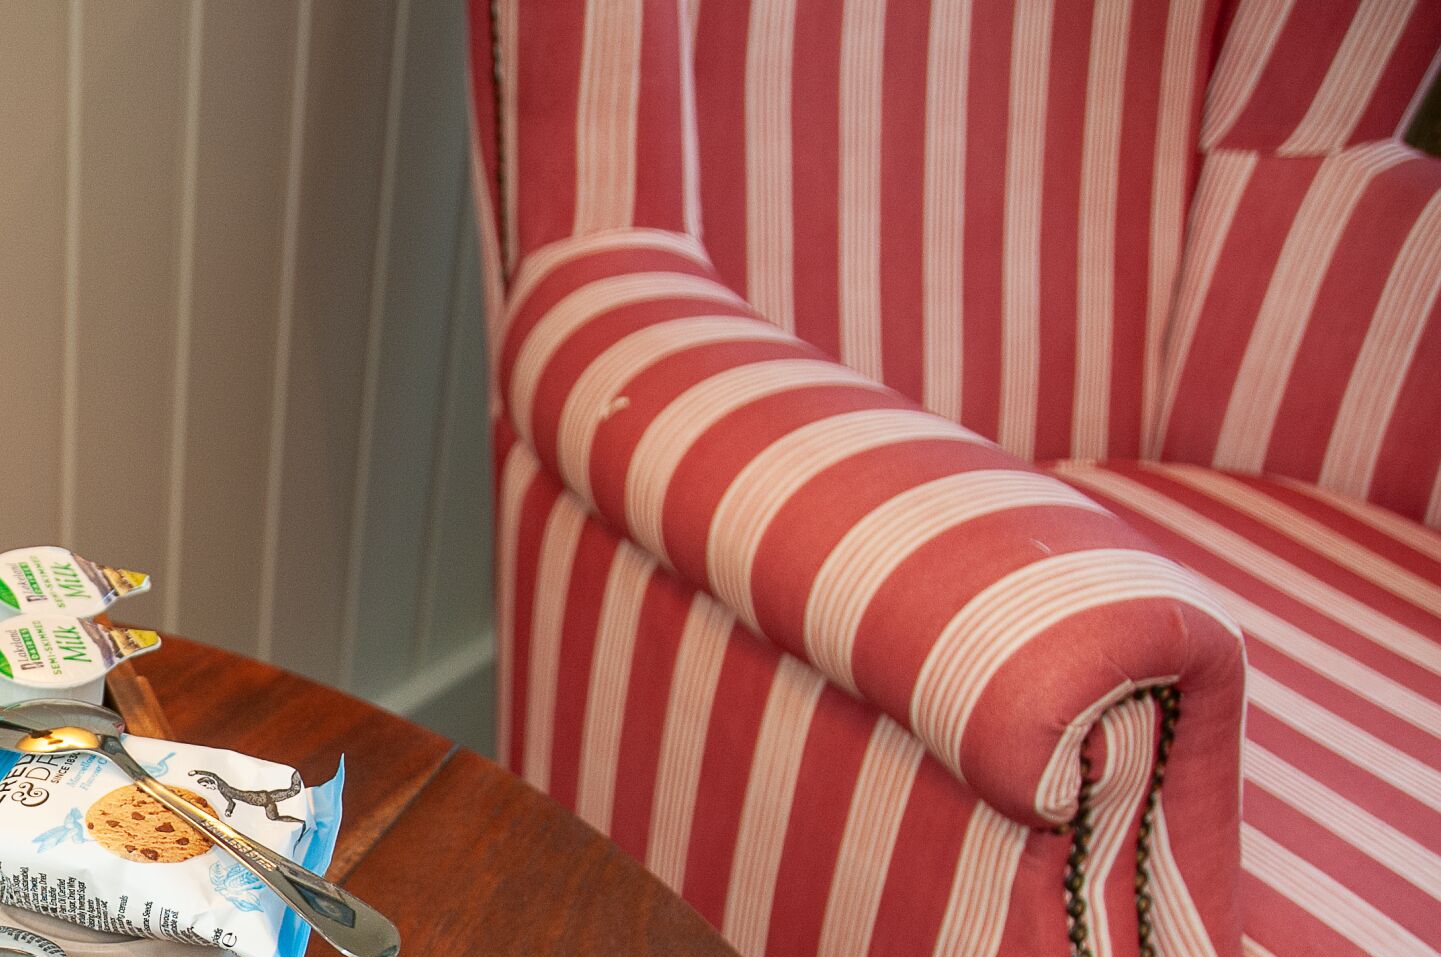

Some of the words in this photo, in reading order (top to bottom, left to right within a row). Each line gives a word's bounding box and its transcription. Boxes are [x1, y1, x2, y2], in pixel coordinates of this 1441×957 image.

[51, 562, 91, 598] Milk
[5, 629, 29, 662] Lakeland
[32, 620, 62, 675] SEMI-SKIMMED
[52, 625, 92, 663] Milk
[25, 754, 65, 781] DR
[51, 766, 70, 784] SINCE
[11, 781, 50, 807] &
